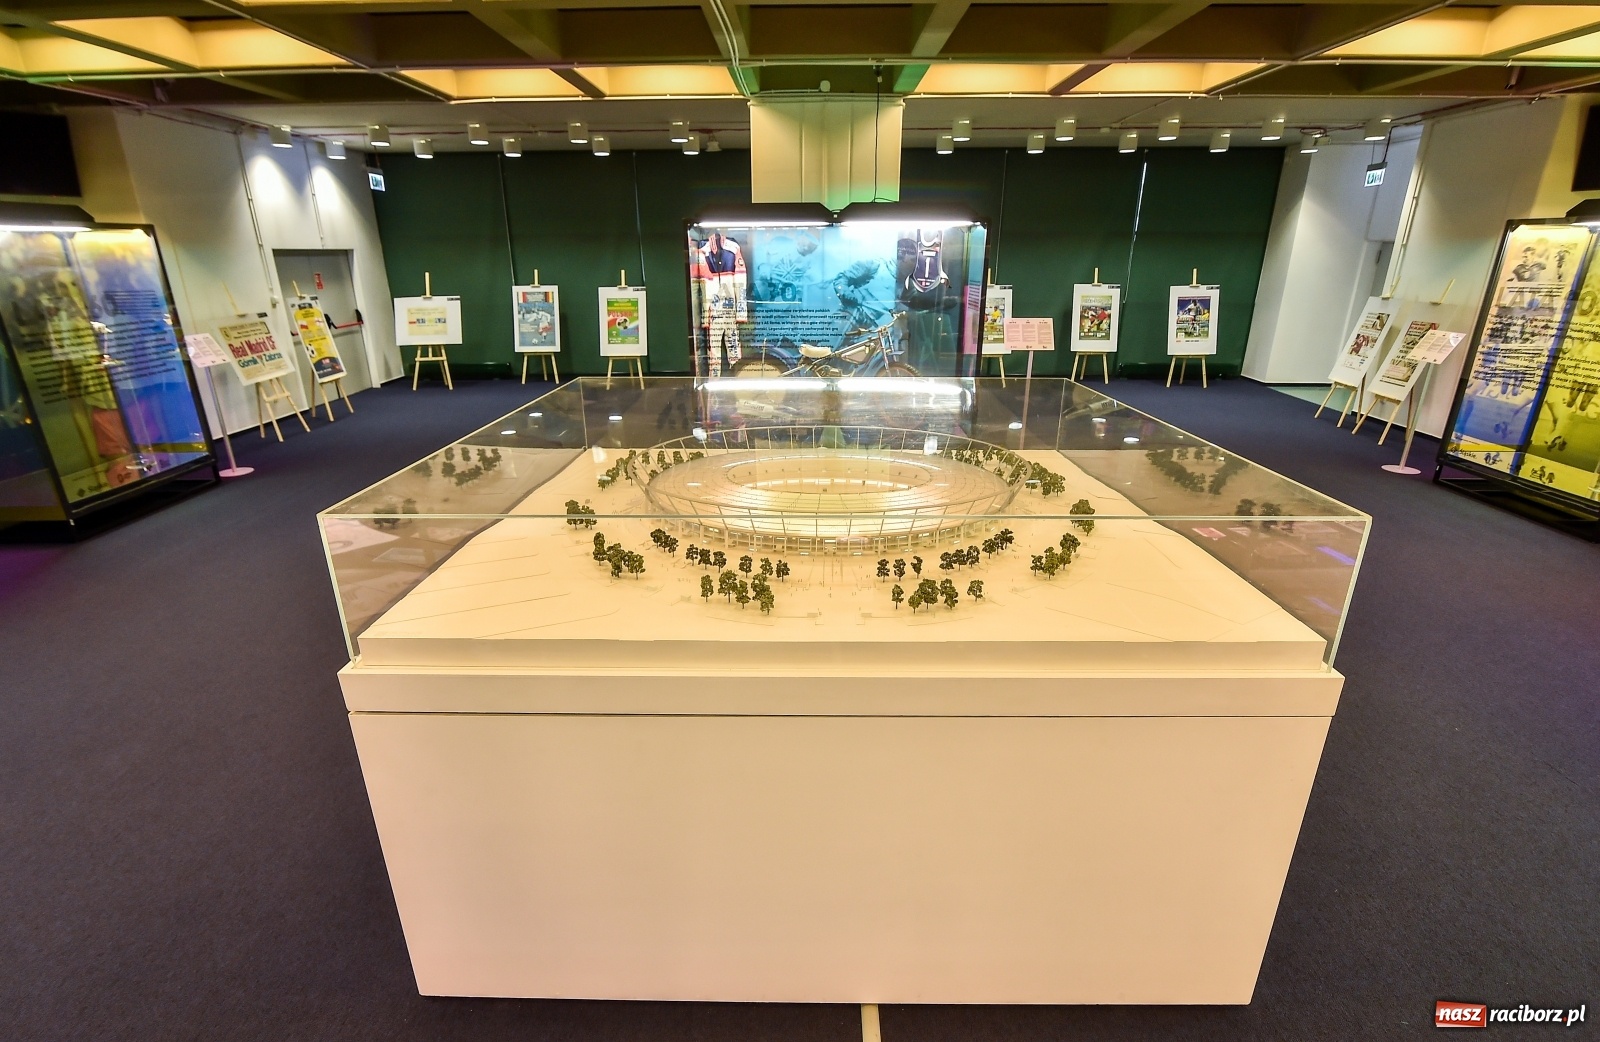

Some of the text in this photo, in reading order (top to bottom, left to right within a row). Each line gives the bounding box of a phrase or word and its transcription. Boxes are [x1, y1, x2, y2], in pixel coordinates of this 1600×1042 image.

[228, 341, 249, 360] Real
[245, 337, 270, 355] Madrid
[238, 352, 283, 368] Górnik Zabrze
